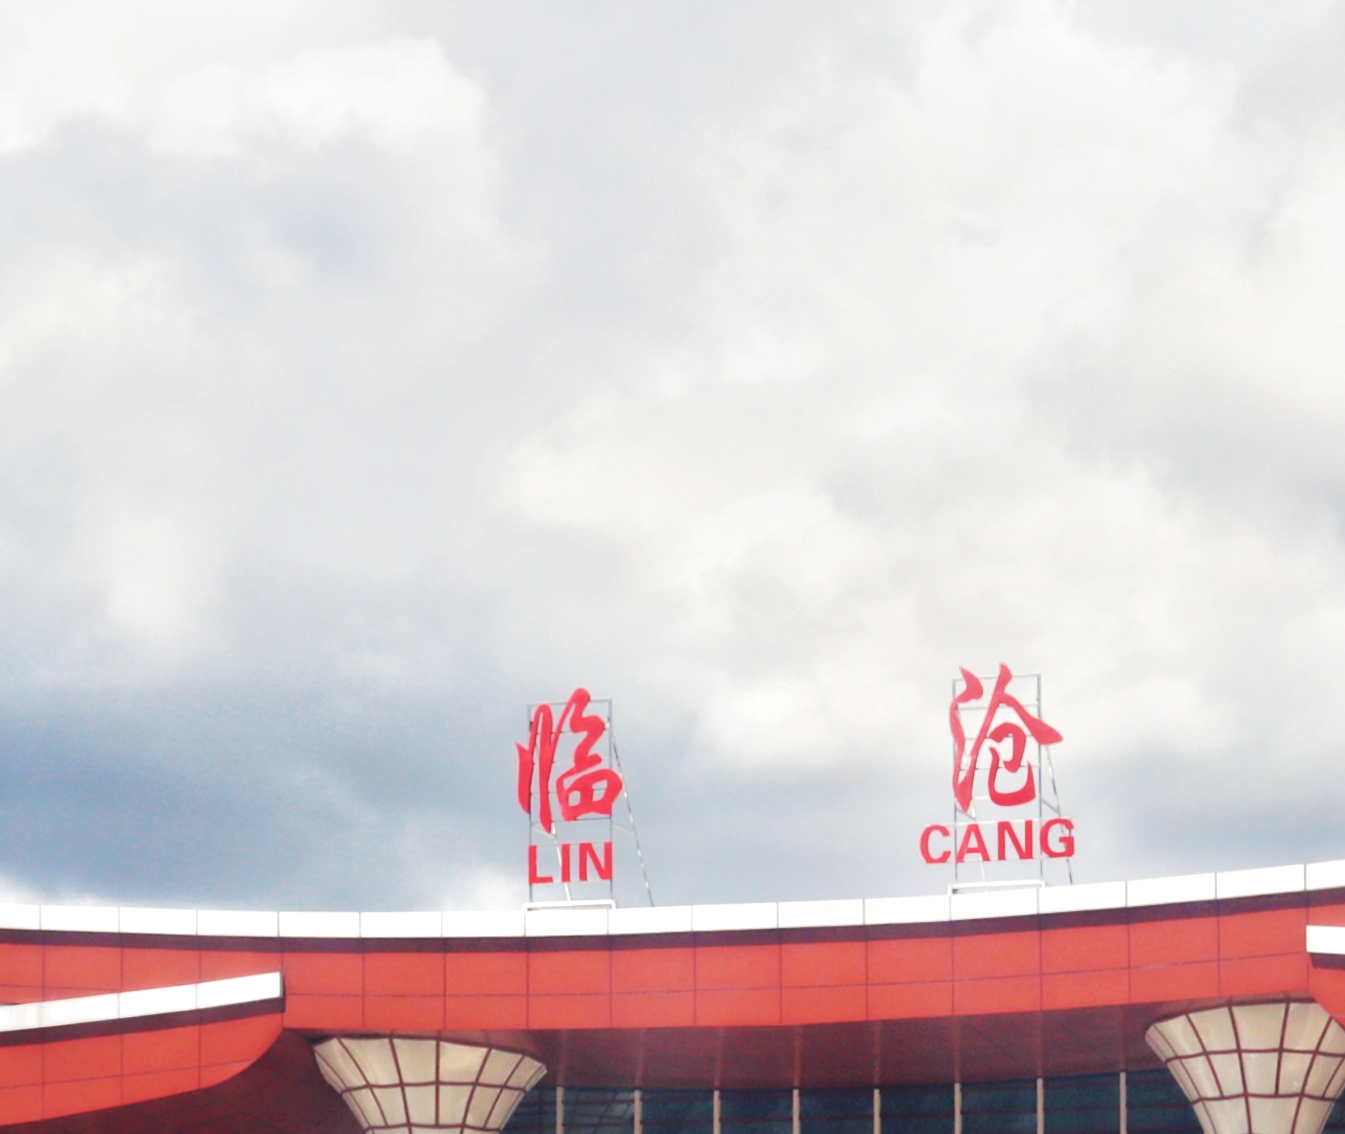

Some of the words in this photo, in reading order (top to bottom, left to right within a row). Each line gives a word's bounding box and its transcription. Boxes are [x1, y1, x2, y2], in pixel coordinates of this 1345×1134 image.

[515, 688, 623, 833] 临
[948, 662, 1064, 812] 沧
[527, 841, 613, 885] LIN
[919, 818, 1076, 864] CANG
